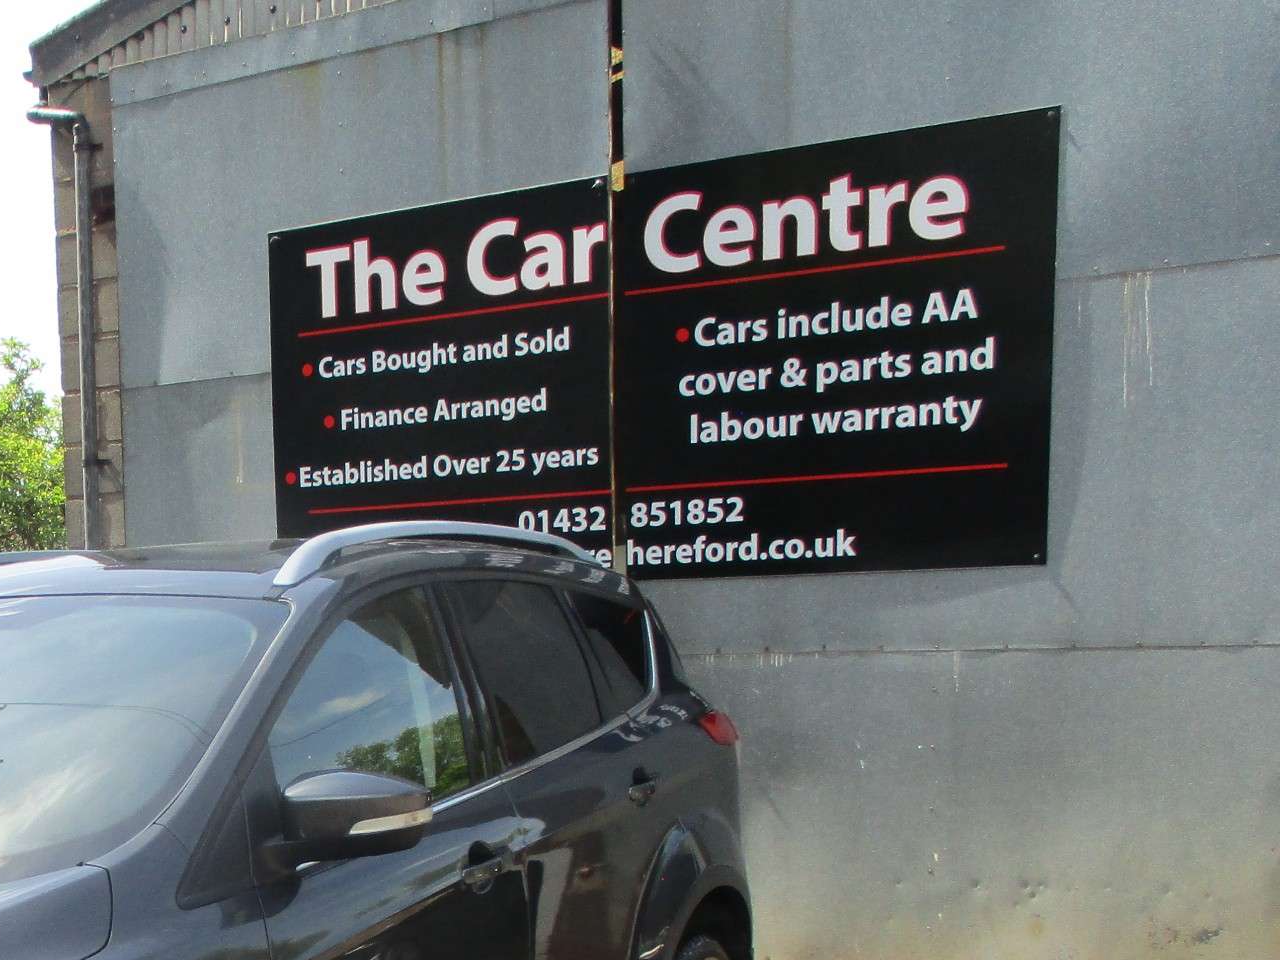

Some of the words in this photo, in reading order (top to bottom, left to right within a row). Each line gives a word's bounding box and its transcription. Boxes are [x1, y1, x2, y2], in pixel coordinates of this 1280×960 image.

[304, 237, 446, 319] The
[466, 217, 607, 297] Car
[642, 172, 969, 274] Centre
[694, 317, 769, 347] Cars
[777, 296, 913, 340] include
[921, 288, 979, 324] AA
[318, 356, 367, 379] Cars
[372, 343, 458, 374] Bought
[463, 334, 508, 363] and
[514, 326, 570, 357] Sold
[678, 367, 772, 397] cover
[780, 357, 807, 388] &
[816, 350, 912, 393] parts
[921, 336, 995, 376] and
[340, 406, 429, 431] Finance
[433, 387, 547, 422] Arranged
[690, 410, 804, 444] labour
[811, 395, 983, 435] warranty
[299, 455, 428, 488] Established
[433, 450, 491, 477] Over
[496, 448, 526, 473] 25
[531, 445, 599, 476] years
[518, 506, 607, 533] 01432
[630, 496, 744, 528] 851852
